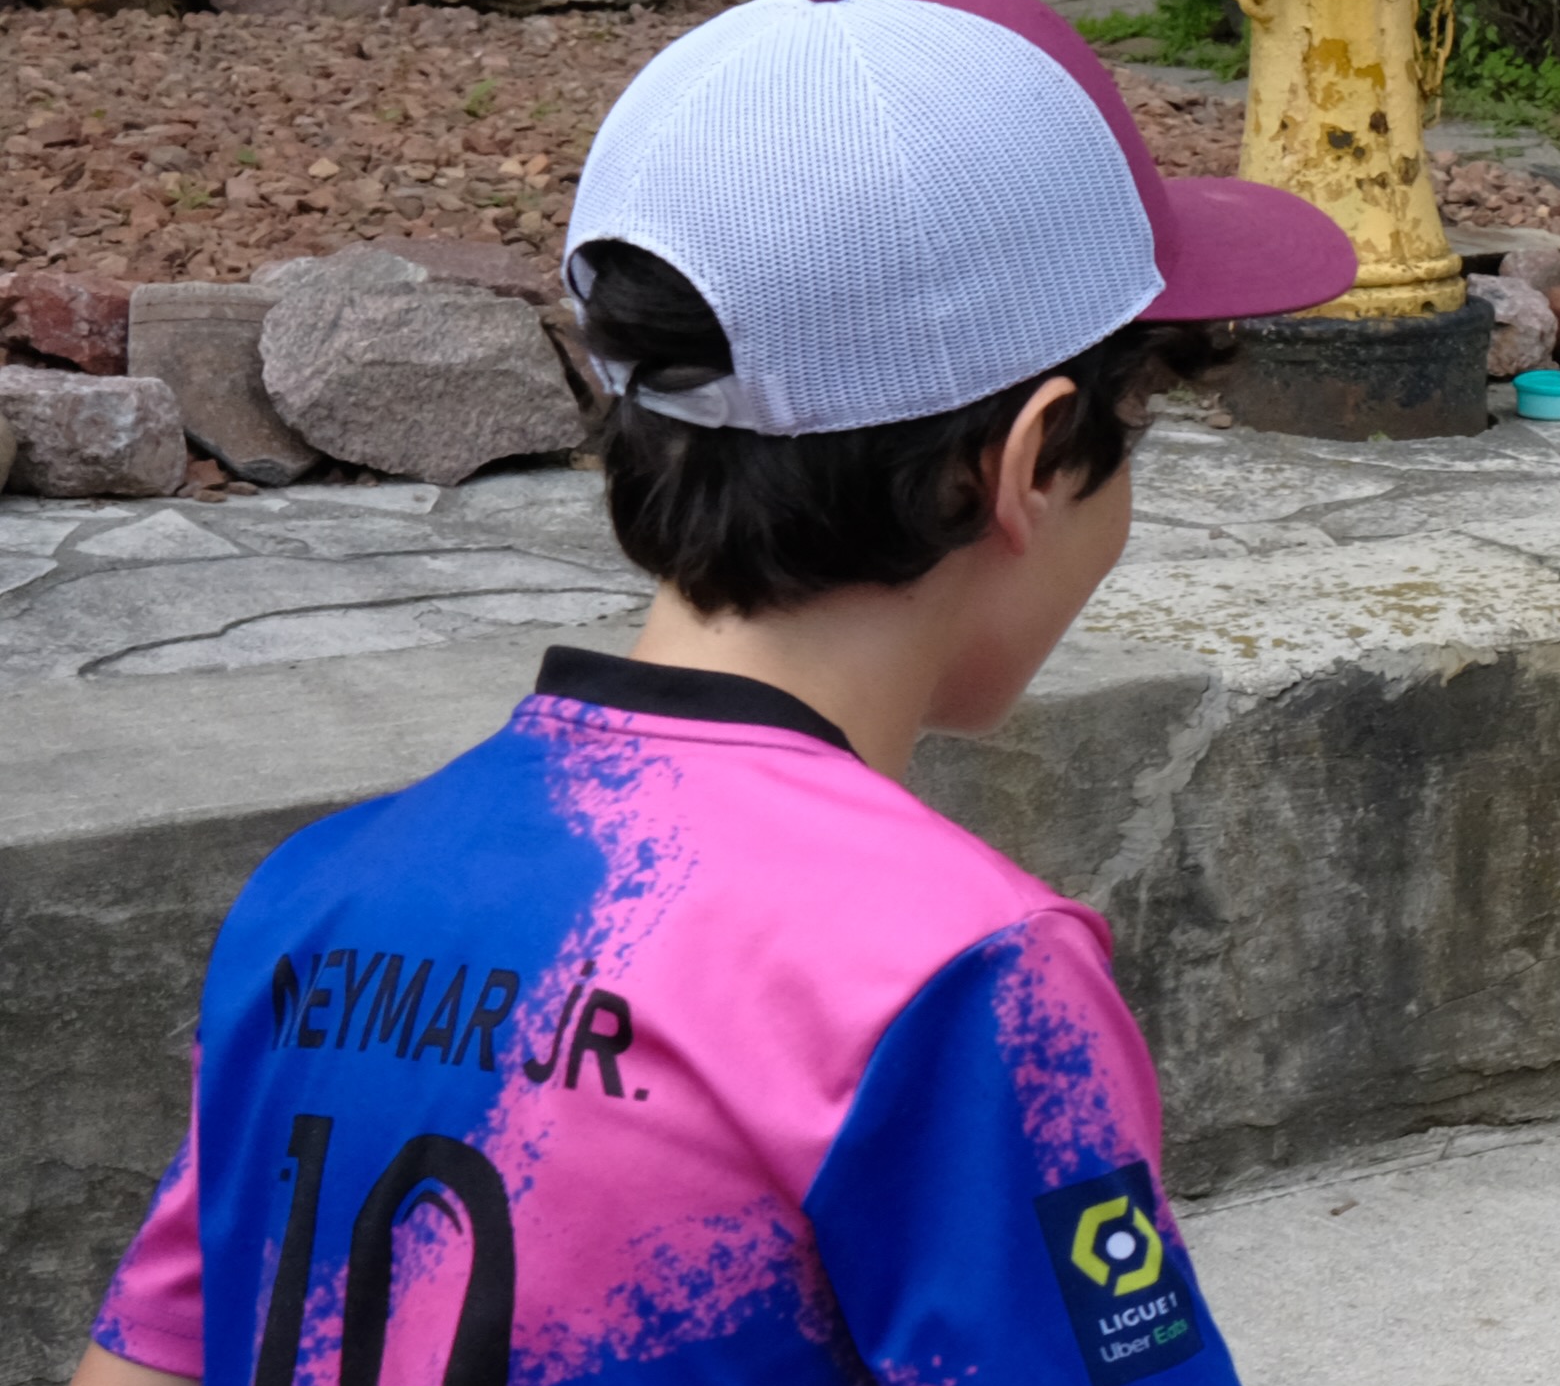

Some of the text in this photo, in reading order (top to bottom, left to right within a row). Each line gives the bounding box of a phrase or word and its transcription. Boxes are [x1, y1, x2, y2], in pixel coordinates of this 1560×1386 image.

[272, 948, 520, 1073] NEYMAR
[1100, 1318, 1189, 1363] Uber Eats
